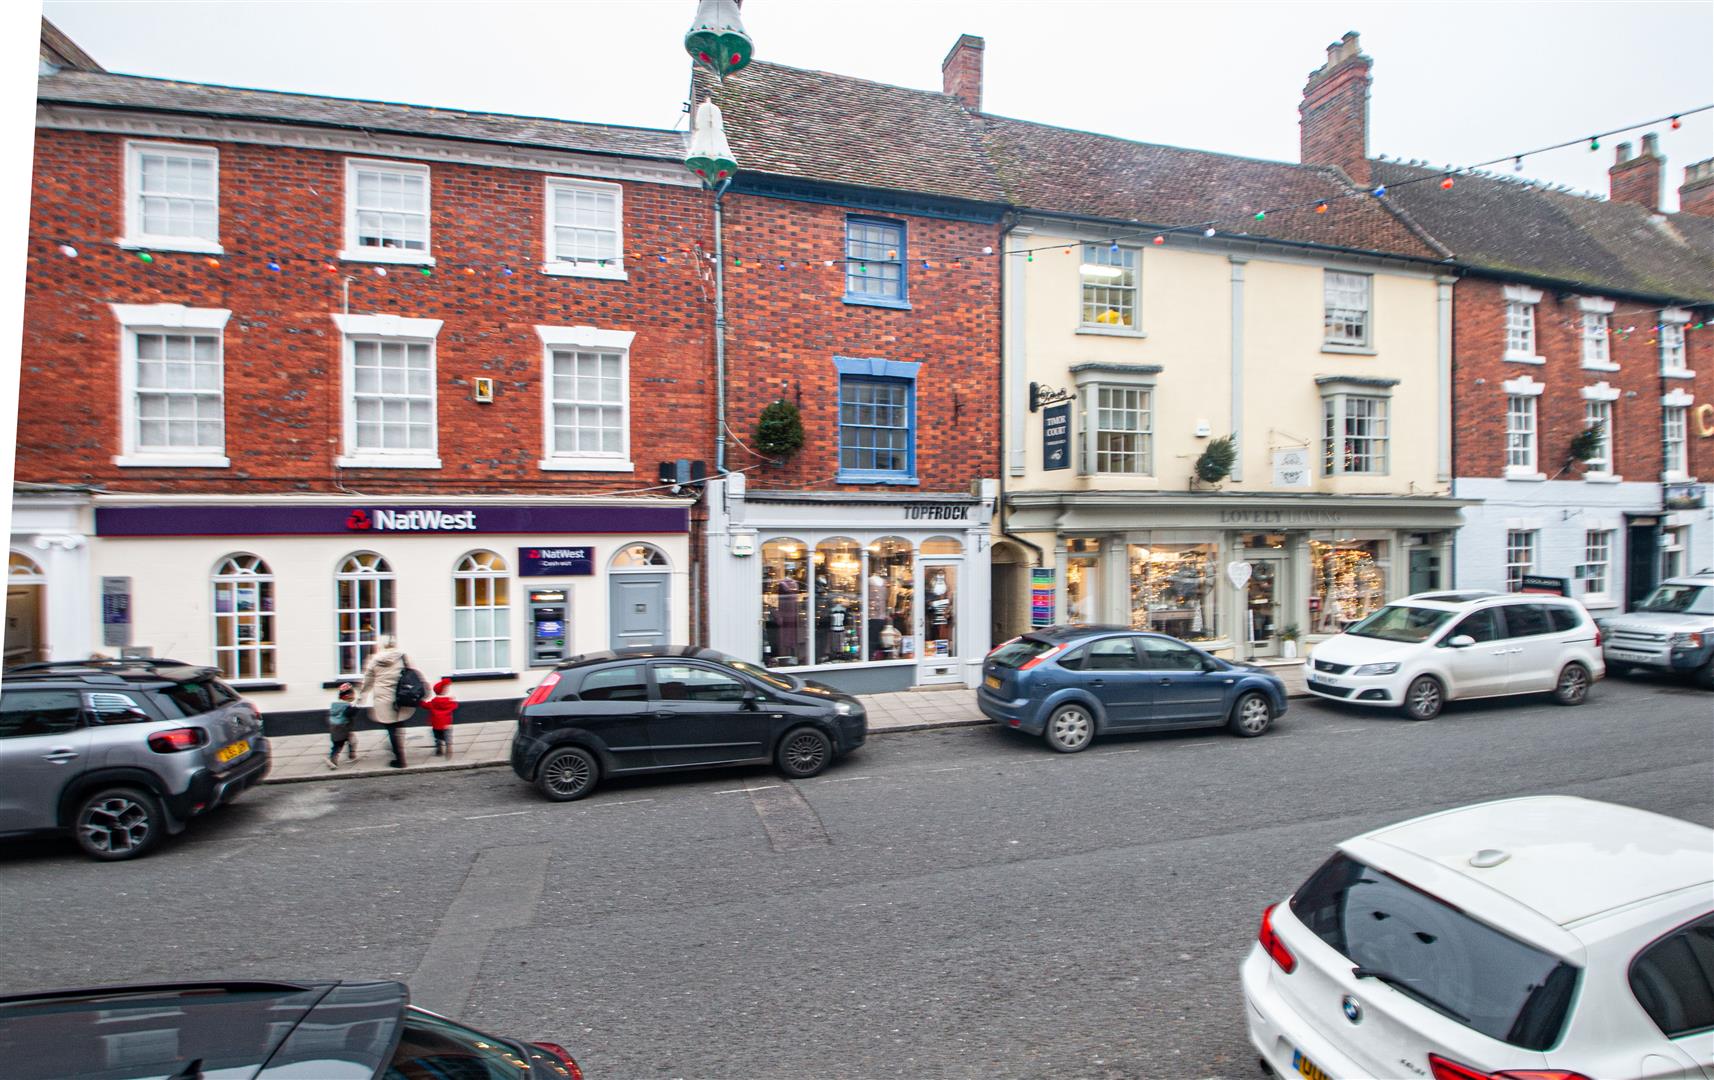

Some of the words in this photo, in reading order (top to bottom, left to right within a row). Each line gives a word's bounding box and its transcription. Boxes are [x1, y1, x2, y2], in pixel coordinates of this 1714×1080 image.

[1047, 426, 1067, 437] COURT
[373, 509, 477, 530] NatWest
[903, 505, 970, 521] TOPFROCK
[1221, 509, 1282, 523] LOVELY
[1288, 510, 1342, 522] LIVING
[541, 549, 585, 559] NatWest
